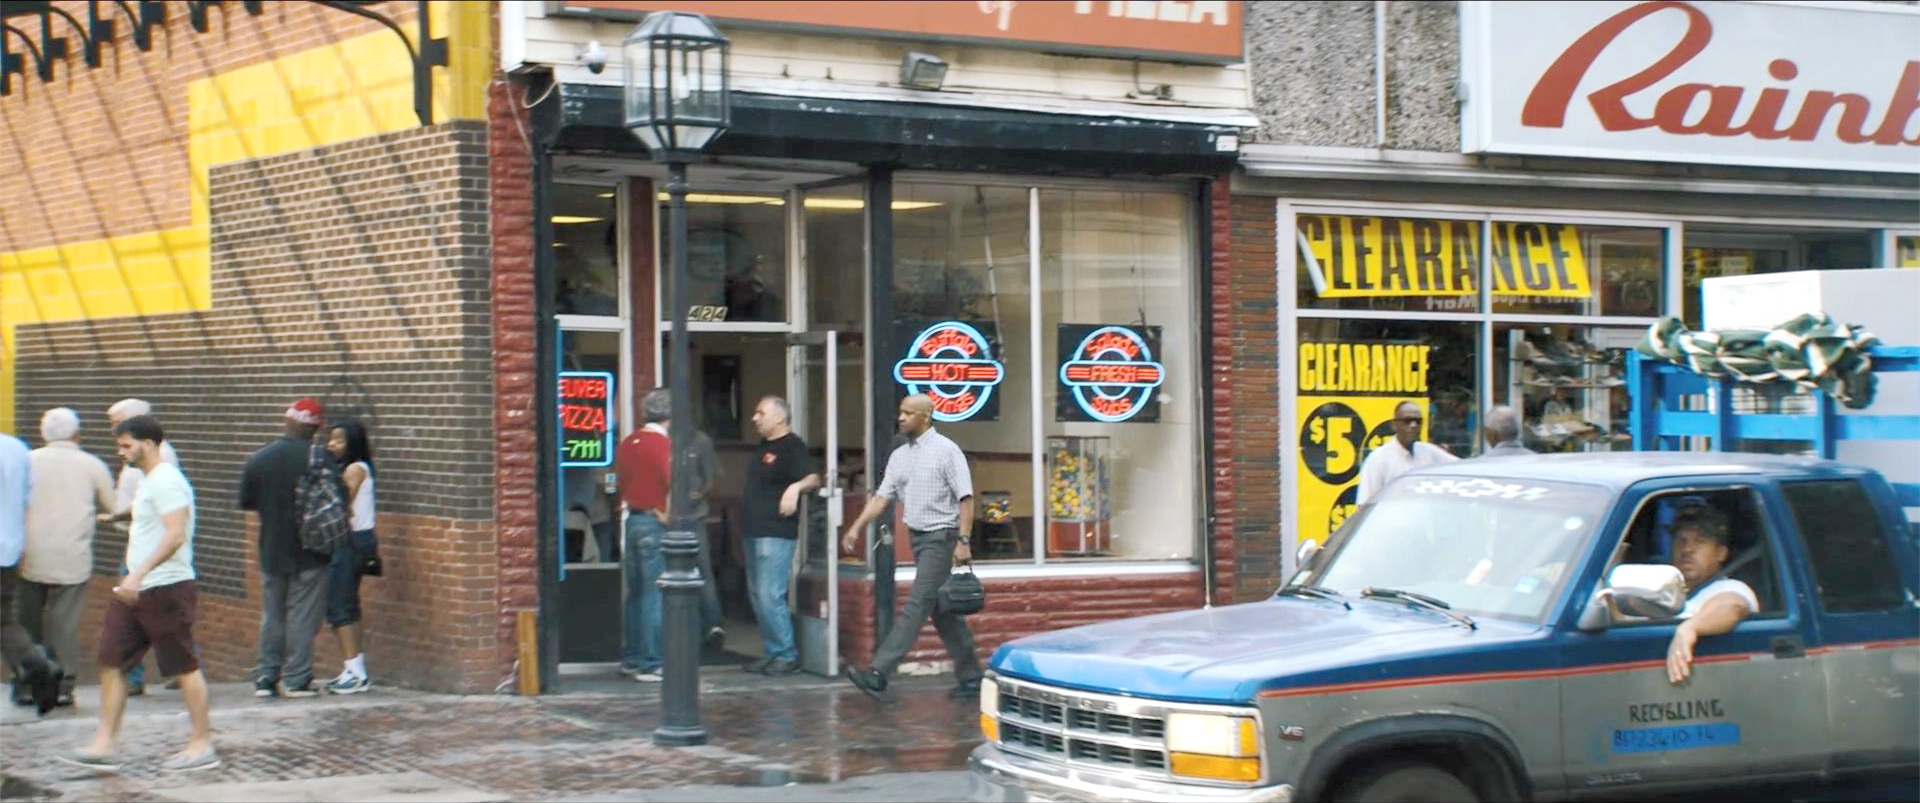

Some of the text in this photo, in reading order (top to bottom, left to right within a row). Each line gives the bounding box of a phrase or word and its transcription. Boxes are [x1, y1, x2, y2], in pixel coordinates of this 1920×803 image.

[688, 305, 728, 321] 424
[930, 363, 970, 381] HOT
[1090, 366, 1137, 382] FRESH
[1300, 343, 1431, 392] CLEARANCE
[557, 378, 608, 399] ELIVER
[1309, 416, 1358, 475] $5
